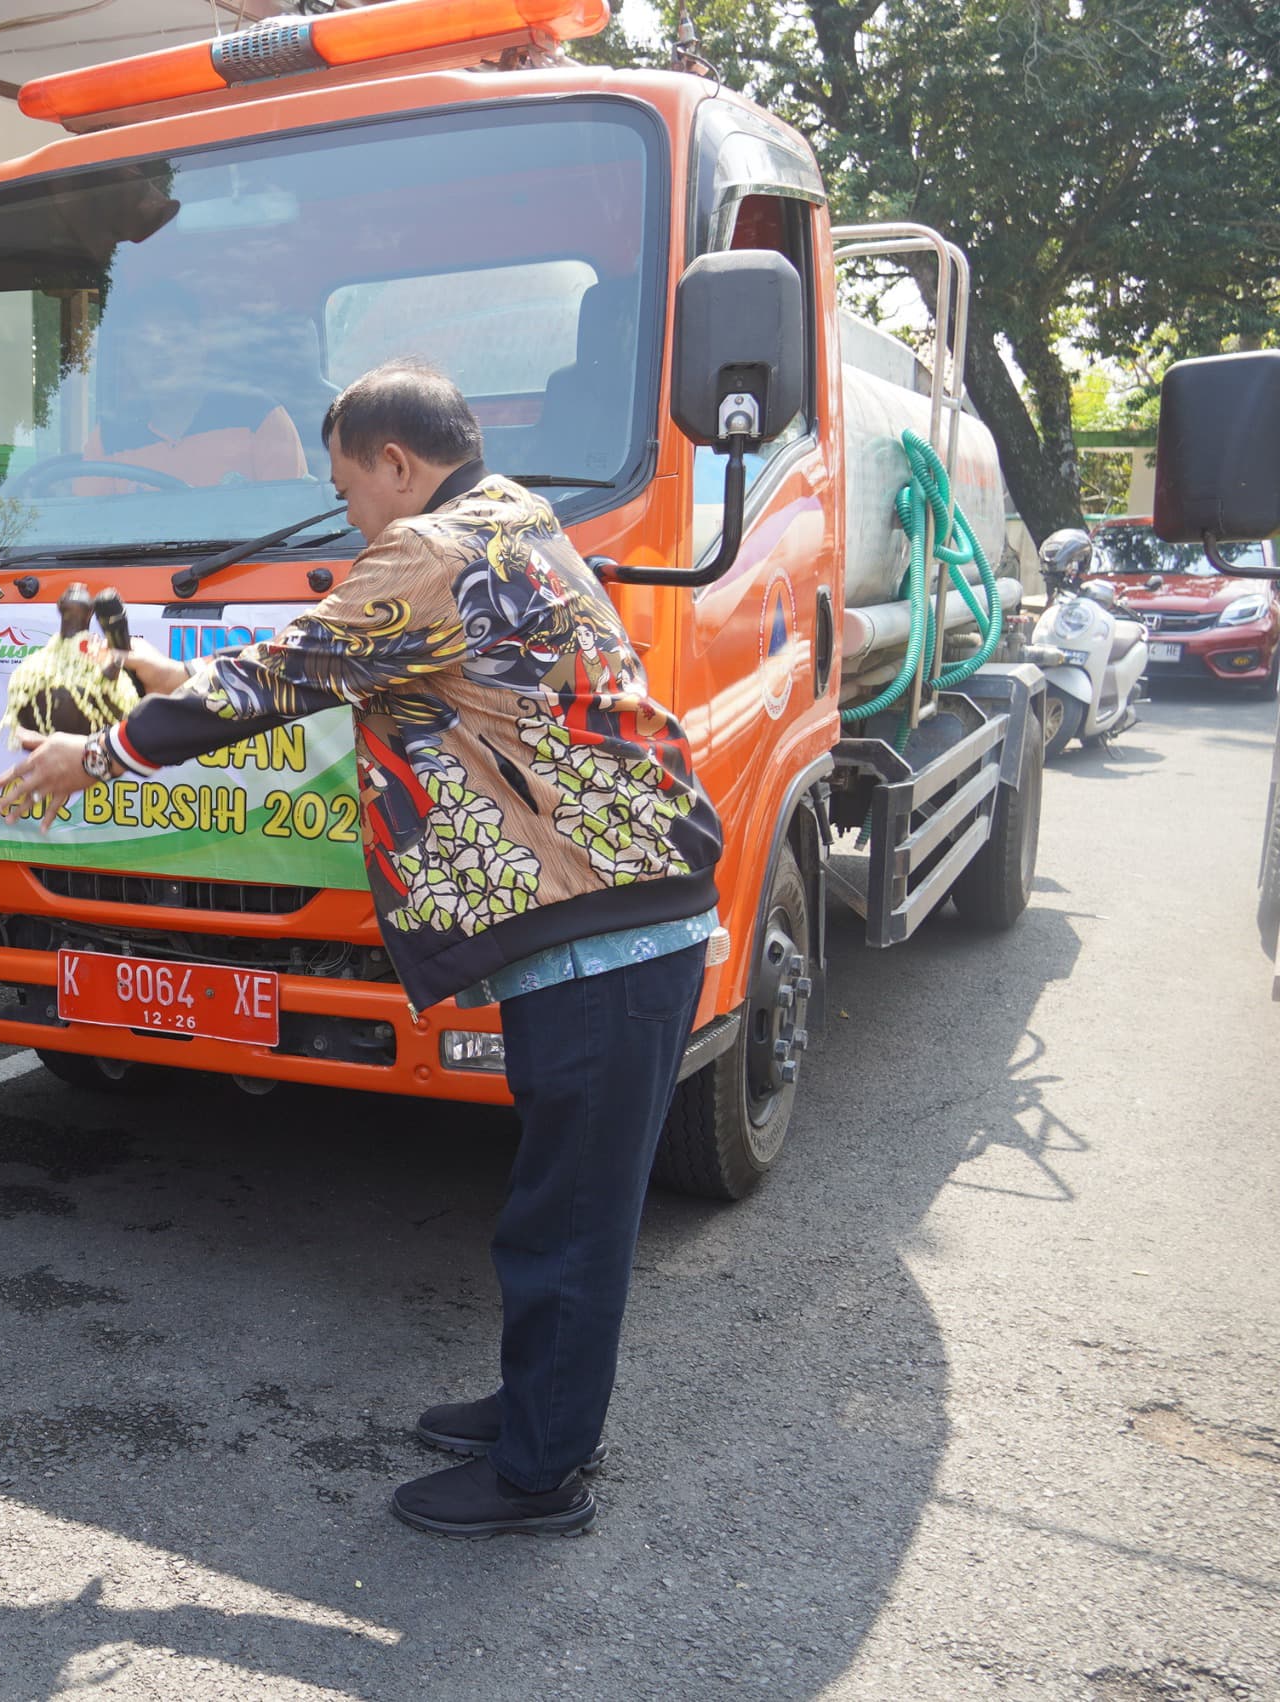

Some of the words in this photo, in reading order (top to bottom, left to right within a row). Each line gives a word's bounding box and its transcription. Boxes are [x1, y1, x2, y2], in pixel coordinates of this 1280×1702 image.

[83, 780, 247, 834] BERSIH
[262, 788, 360, 843] 202
[64, 955, 80, 997] K
[116, 962, 195, 1009] 8064
[233, 973, 272, 1019] XE
